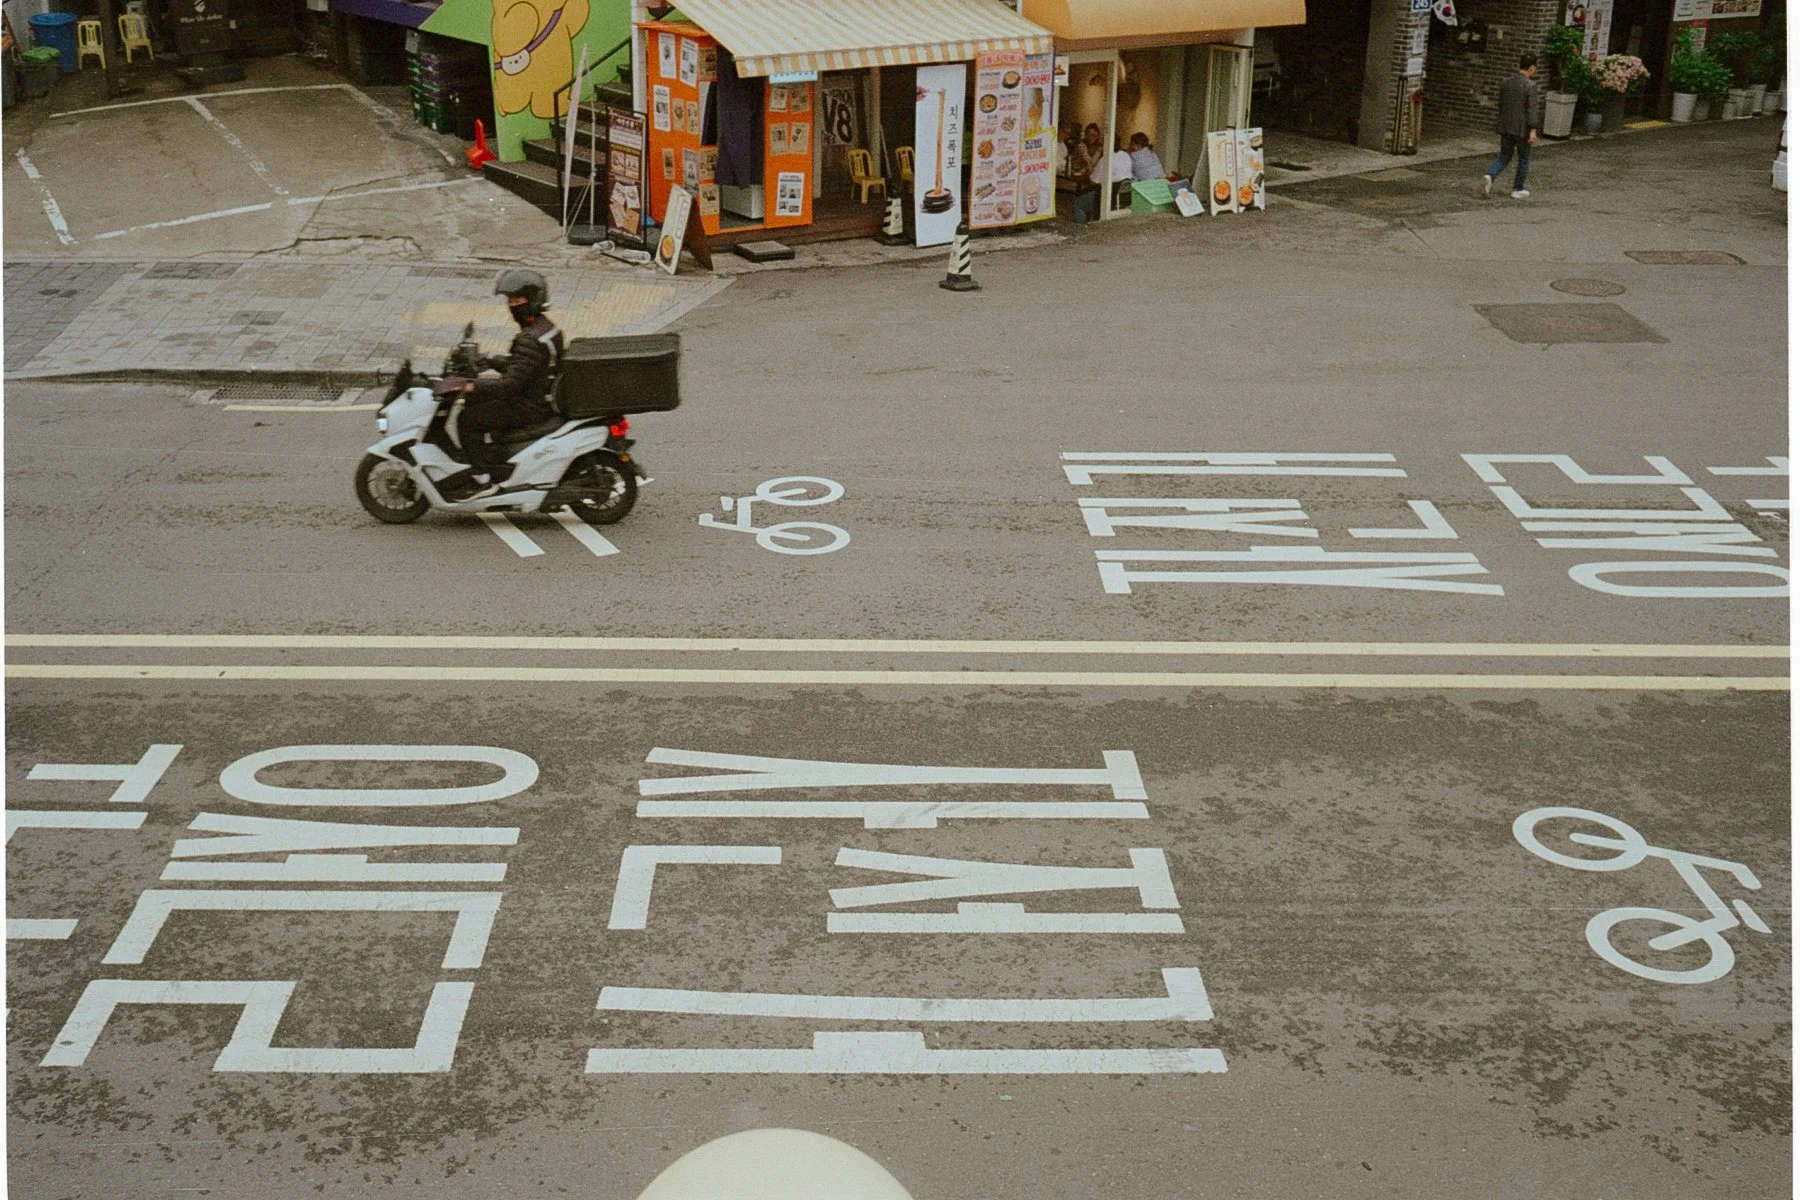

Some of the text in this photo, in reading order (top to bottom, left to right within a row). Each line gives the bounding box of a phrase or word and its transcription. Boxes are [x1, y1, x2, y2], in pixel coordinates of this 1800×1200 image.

[822, 90, 852, 143] V8
[946, 104, 959, 169] 치즈폭포
[1061, 452, 1504, 597] 자전거
[585, 747, 1228, 1074] 자전거
